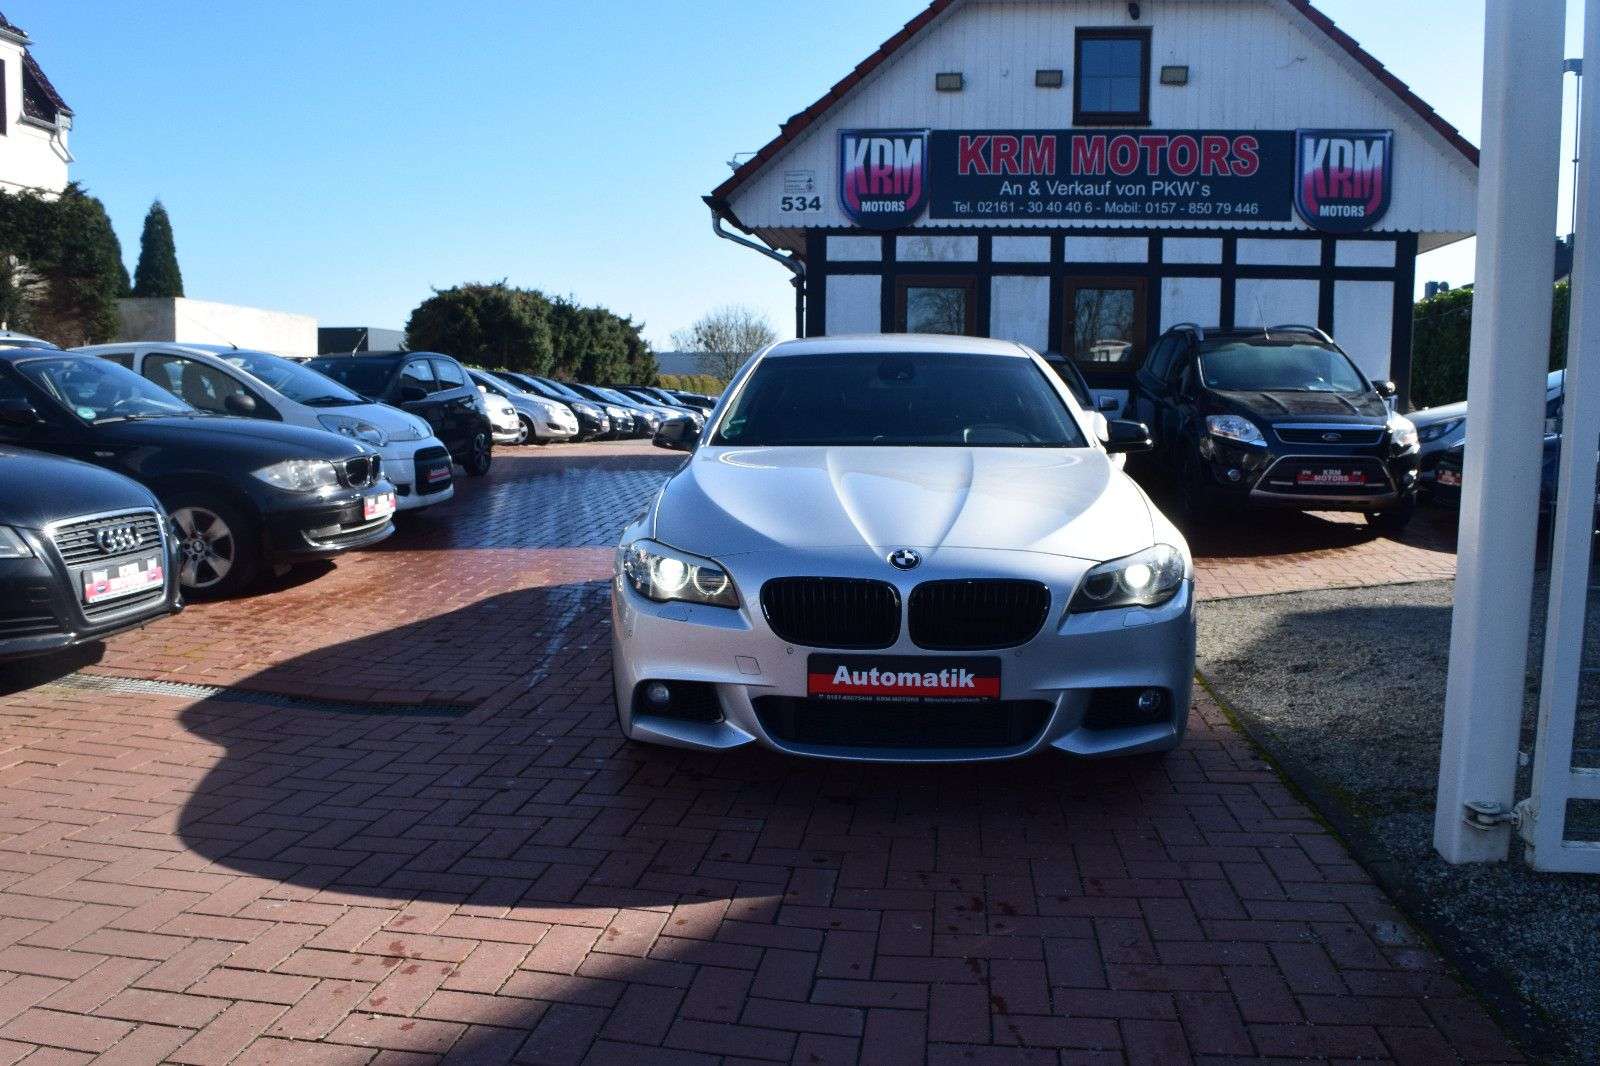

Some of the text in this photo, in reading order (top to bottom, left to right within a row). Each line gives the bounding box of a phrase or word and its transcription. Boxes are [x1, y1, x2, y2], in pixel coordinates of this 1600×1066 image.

[958, 134, 1260, 177] KRM MOTORS
[1000, 180, 1023, 195] An
[1028, 180, 1040, 196] &
[1046, 180, 1112, 196] Verkauf
[1115, 184, 1146, 196] von
[781, 196, 821, 211] 534
[861, 201, 905, 212] MOTORS
[953, 201, 974, 213] Tel.
[977, 201, 1014, 213] 02161
[1028, 201, 1043, 213] 30
[1046, 201, 1063, 213] 40
[1065, 201, 1082, 213] 40
[1084, 202, 1093, 213] 6
[1104, 201, 1141, 214] Mobil:
[1145, 202, 1177, 214] 0157
[1188, 202, 1213, 214] 850
[1216, 202, 1232, 214] 79
[1234, 202, 1259, 215] 446
[1319, 205, 1365, 217] MOTORS
[832, 665, 976, 688] Automatik
